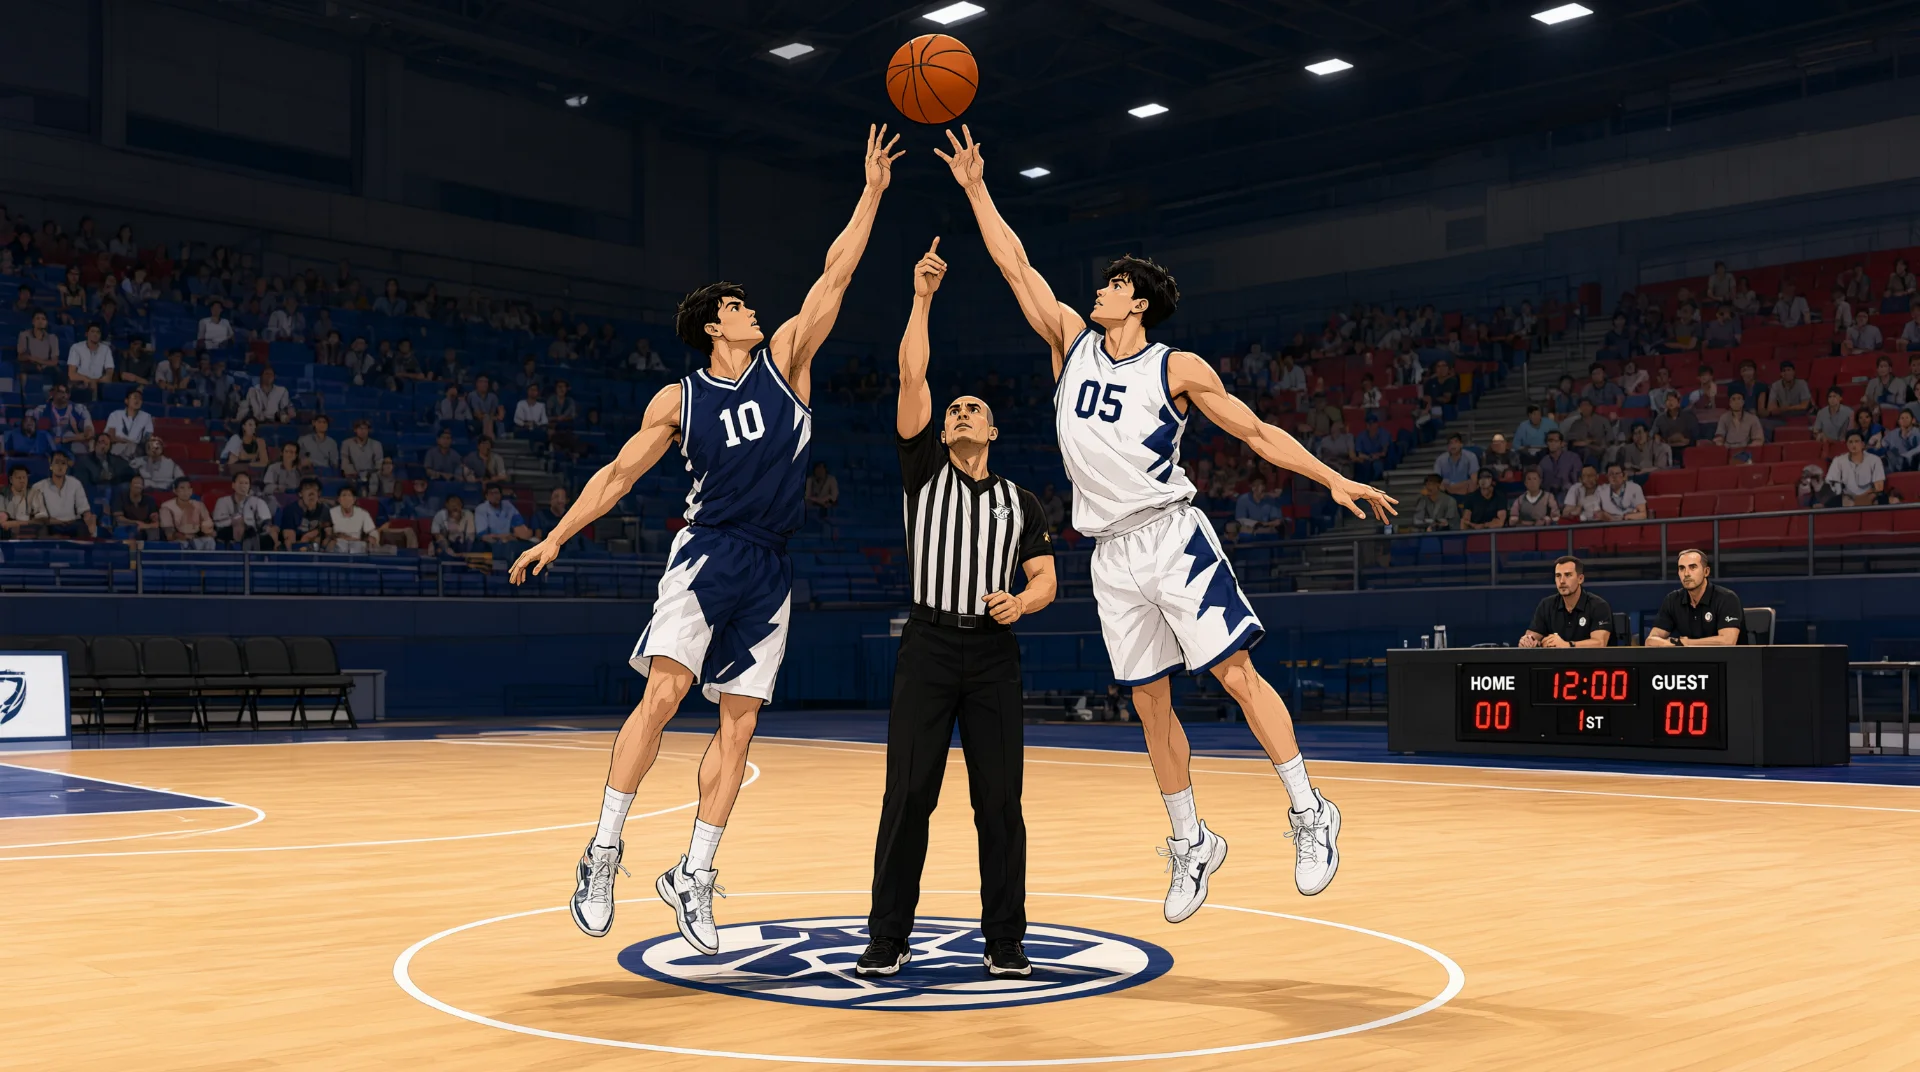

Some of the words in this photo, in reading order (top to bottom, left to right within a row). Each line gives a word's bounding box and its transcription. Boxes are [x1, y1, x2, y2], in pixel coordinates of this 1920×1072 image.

[1075, 379, 1127, 423] 05
[719, 400, 765, 447] 10
[1471, 675, 1515, 691] HOME
[1553, 670, 1628, 700] 12:00
[1652, 674, 1709, 691] GUEST
[1475, 701, 1510, 730] 00
[1578, 709, 1604, 731] 1ST
[1665, 701, 1708, 735] 00
